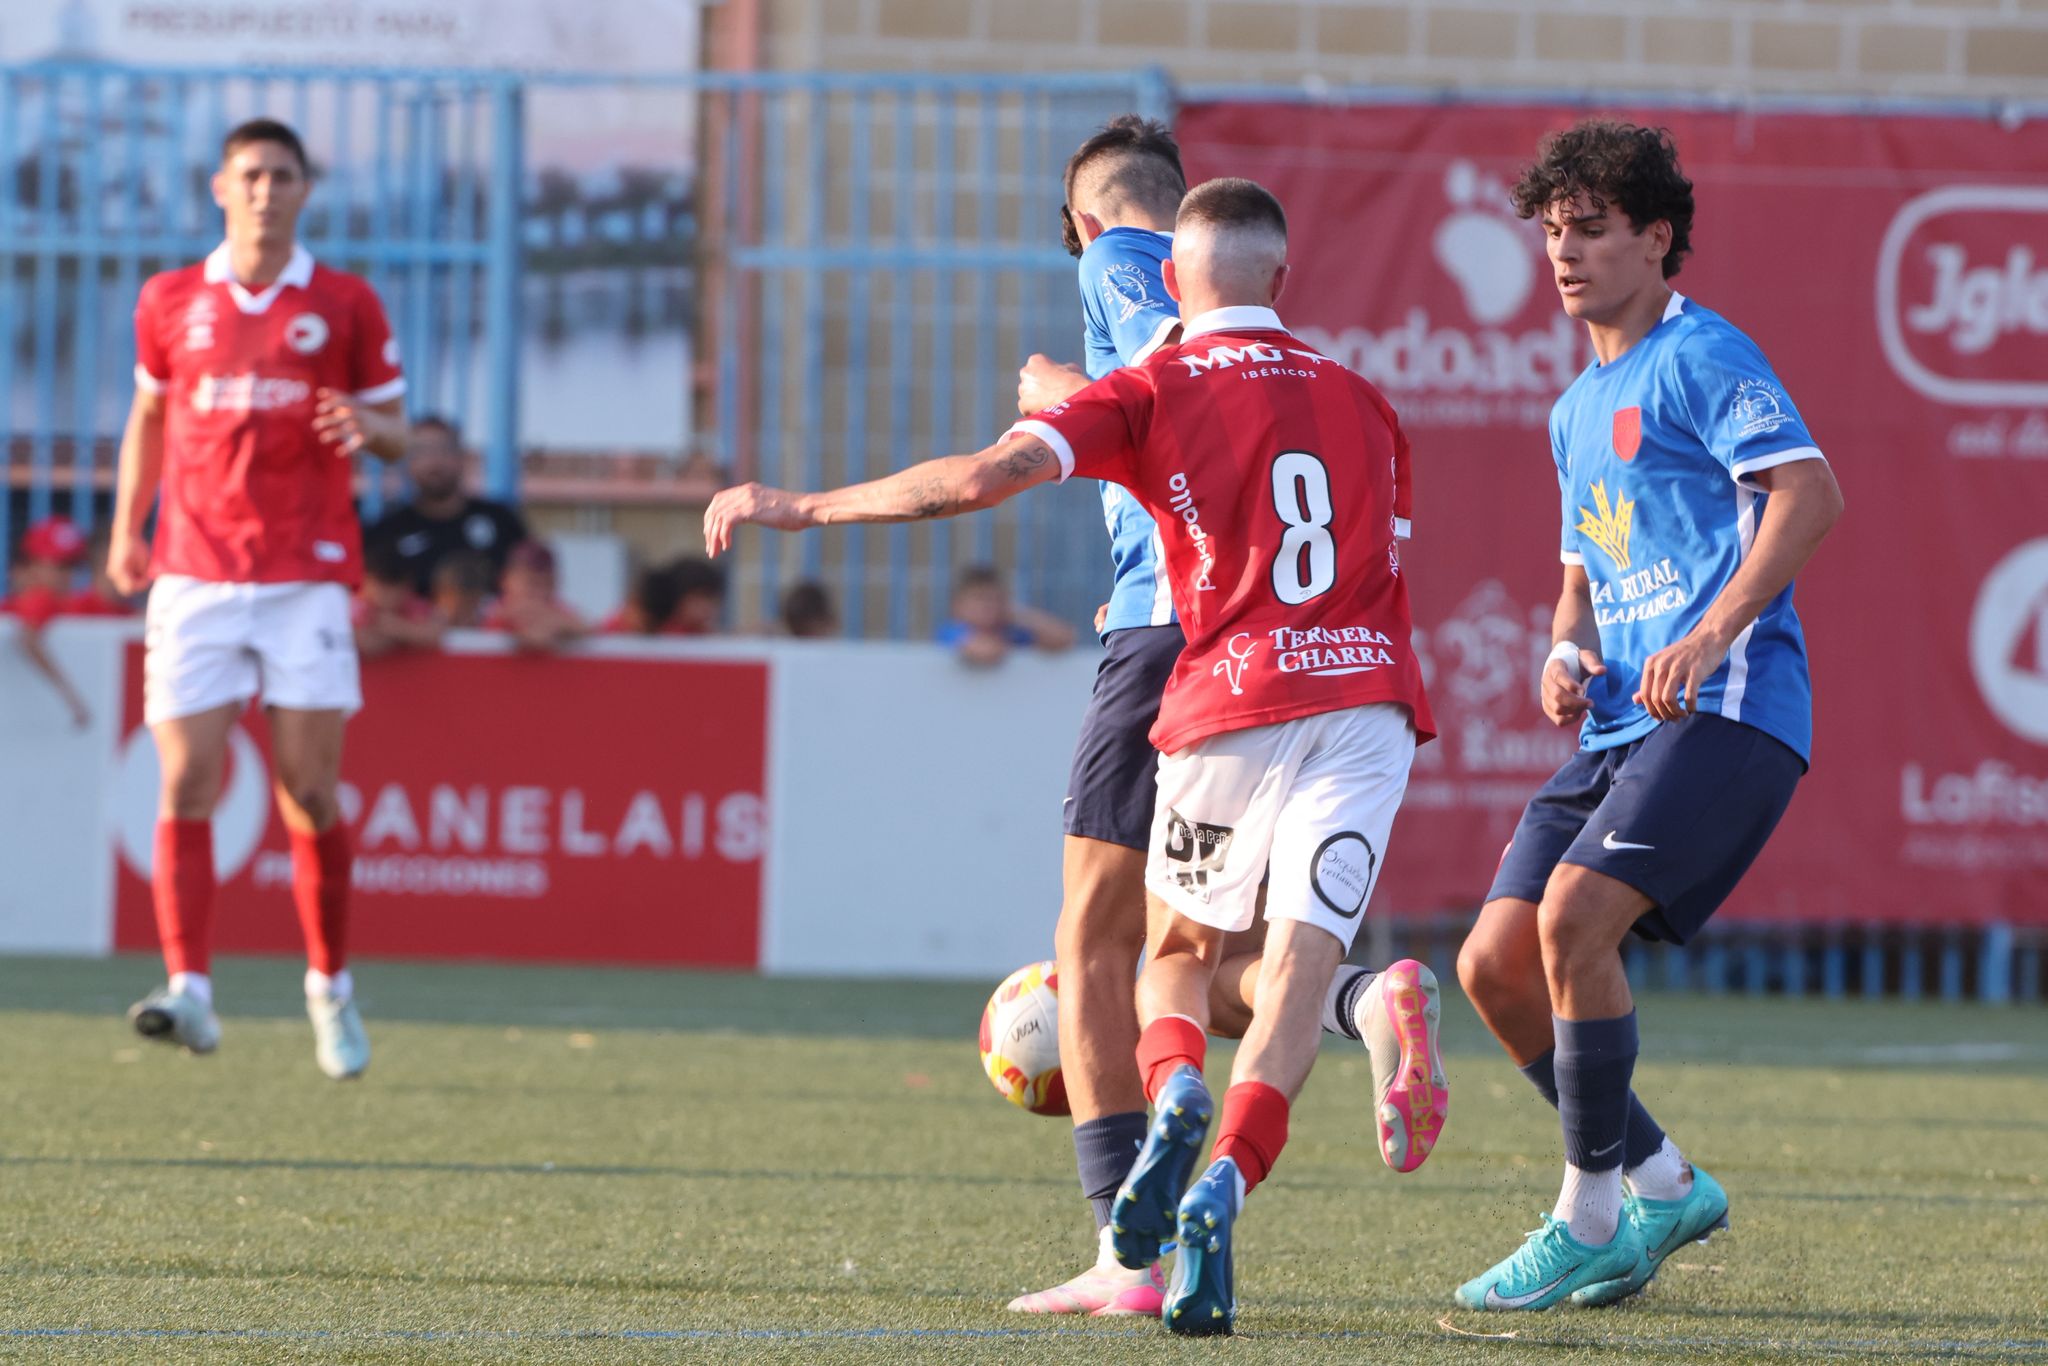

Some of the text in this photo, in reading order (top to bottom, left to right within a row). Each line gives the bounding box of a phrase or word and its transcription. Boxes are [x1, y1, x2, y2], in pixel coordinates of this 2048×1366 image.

[1241, 366, 1318, 381] IBÉRICOS
[1271, 449, 1337, 606] 8
[1619, 557, 1679, 603] RURAL
[1268, 625, 1394, 651] TERNERA
[1276, 646, 1397, 674] CHARRA
[252, 850, 549, 899] PRUCCIONES
